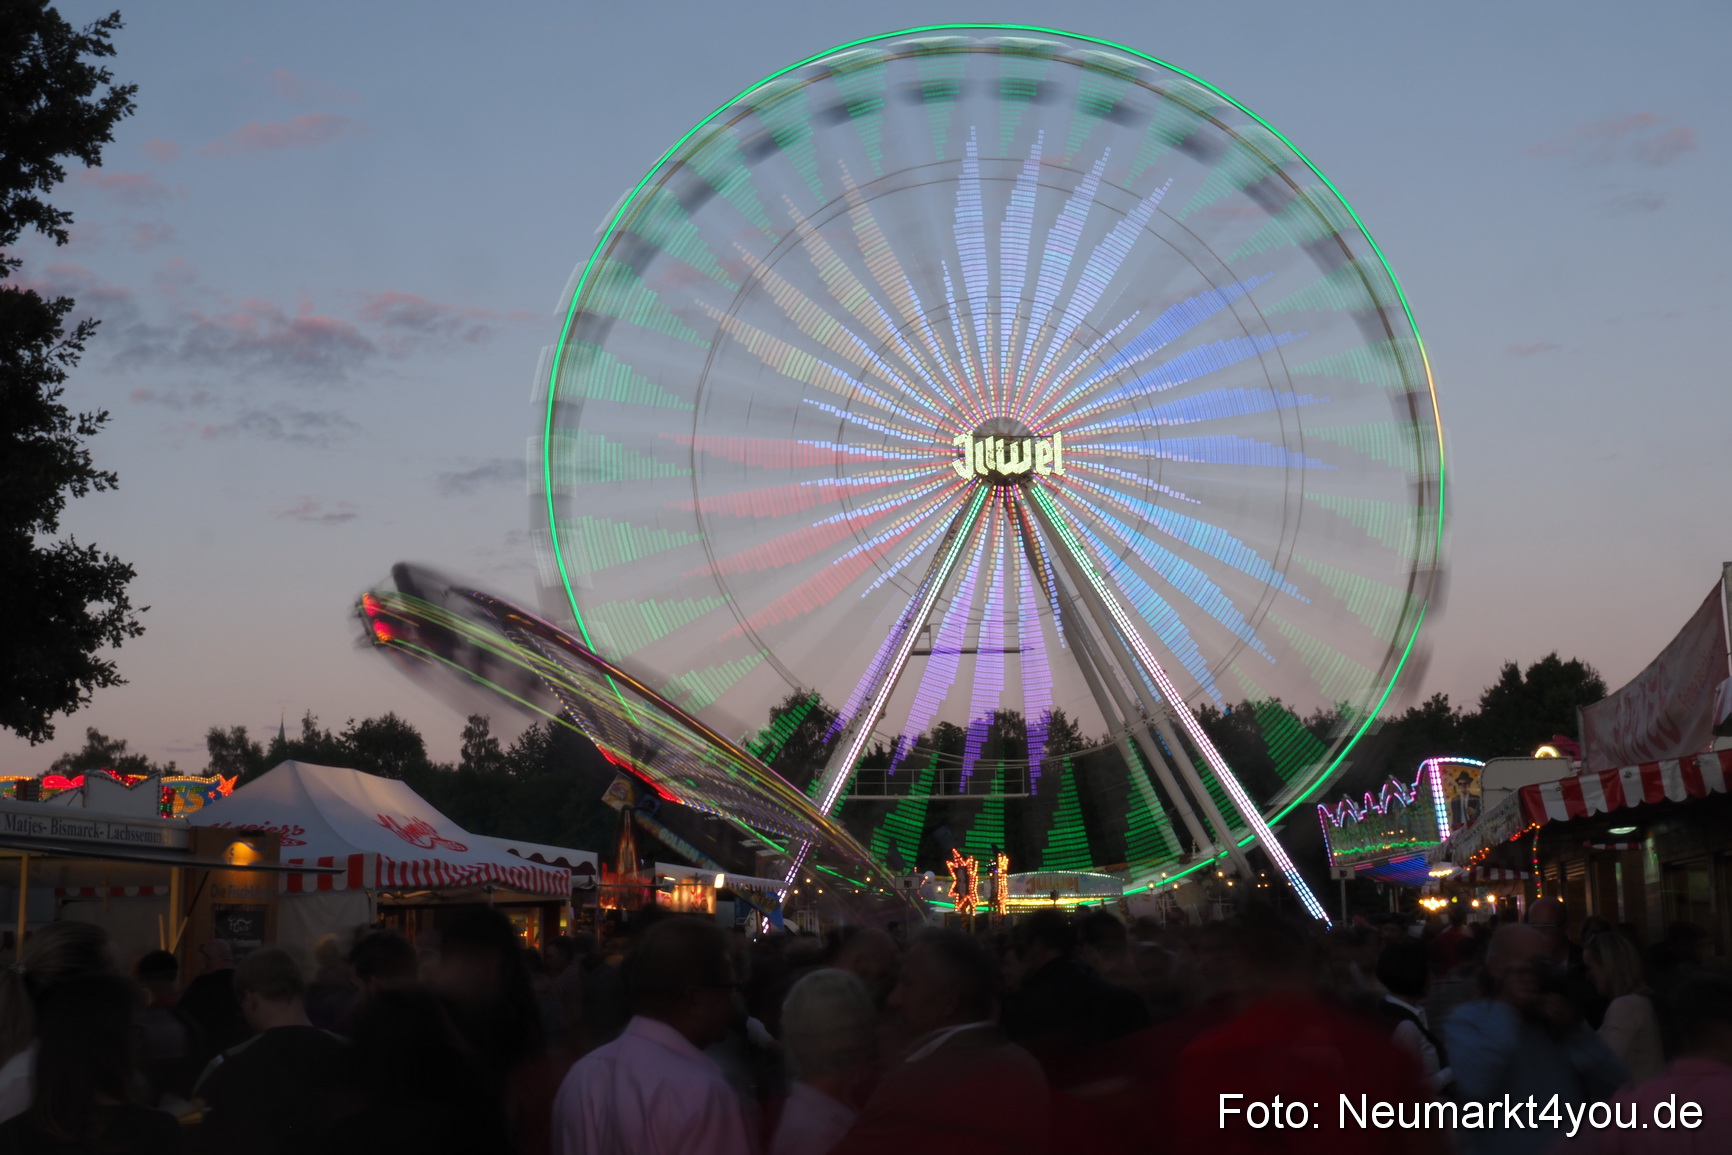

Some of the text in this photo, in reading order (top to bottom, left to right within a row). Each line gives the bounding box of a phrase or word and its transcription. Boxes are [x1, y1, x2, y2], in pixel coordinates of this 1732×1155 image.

[952, 430, 1066, 480] Juwel
[4, 813, 47, 836] Matjes-
[50, 818, 104, 840] Bismarck-
